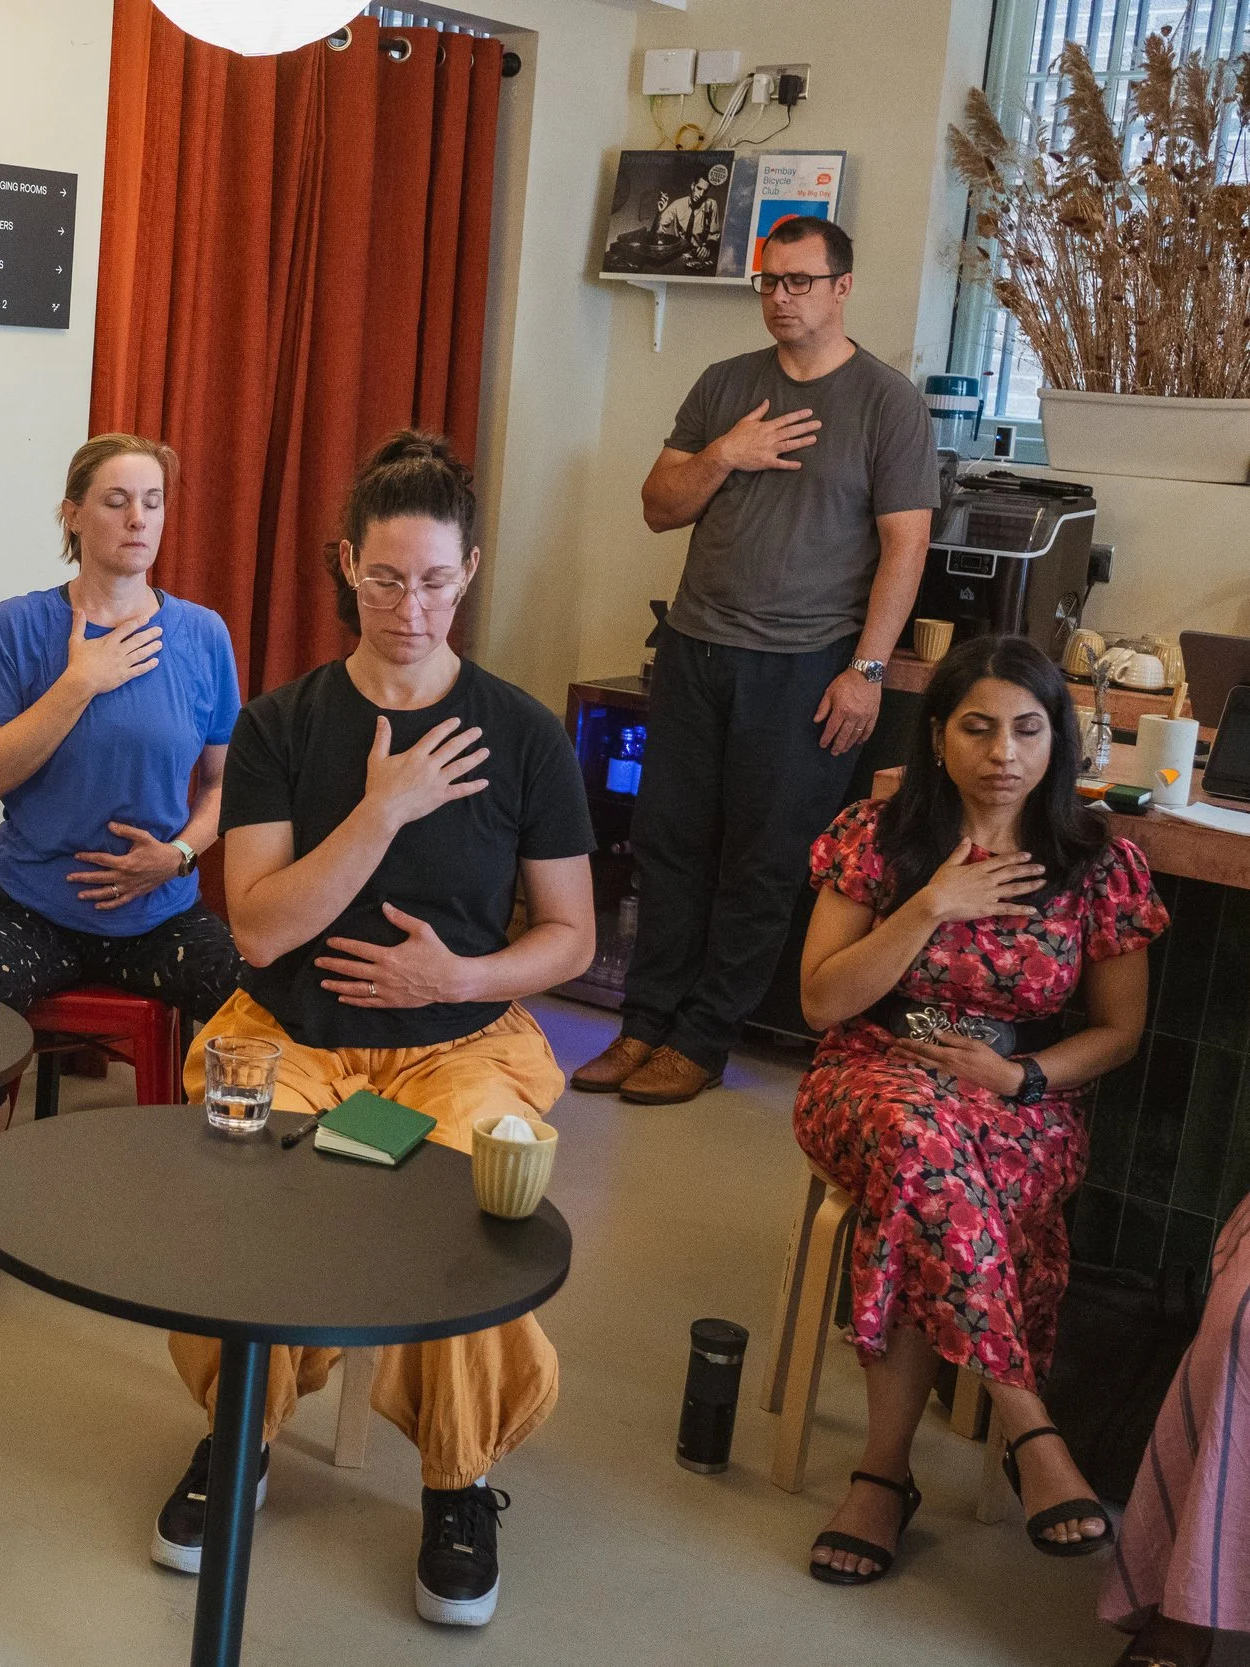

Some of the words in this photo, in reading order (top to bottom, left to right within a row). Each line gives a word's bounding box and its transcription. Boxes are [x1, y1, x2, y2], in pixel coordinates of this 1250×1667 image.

[763, 176, 791, 187] Bicycle
[19, 183, 48, 195] ROOMS
[762, 186, 780, 195] Club
[2, 299, 8, 309] 2
